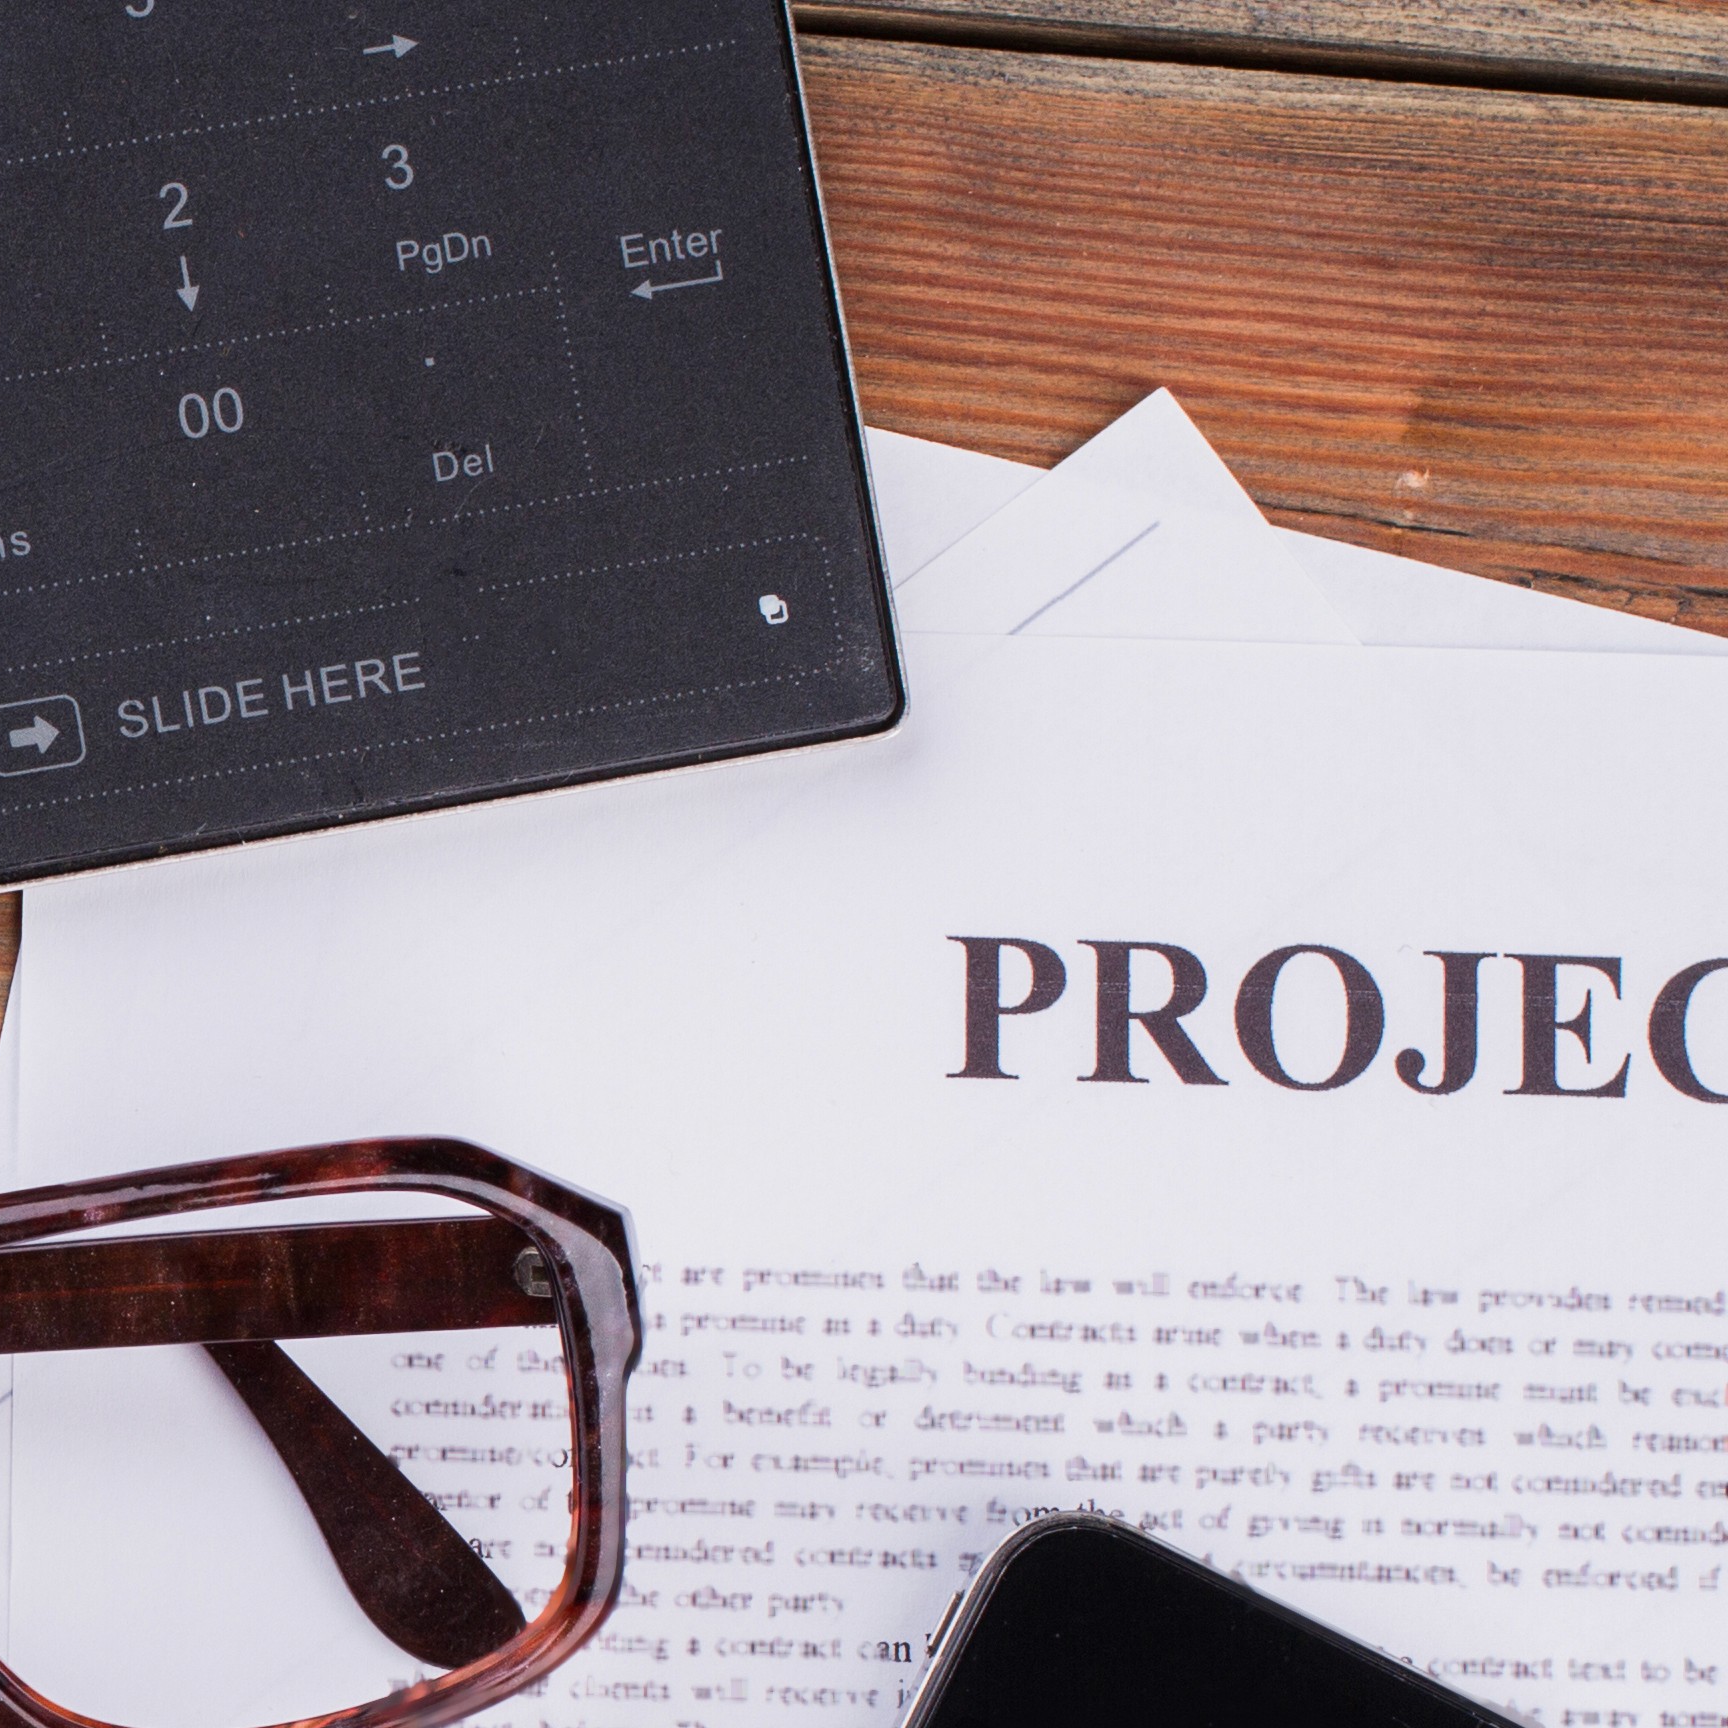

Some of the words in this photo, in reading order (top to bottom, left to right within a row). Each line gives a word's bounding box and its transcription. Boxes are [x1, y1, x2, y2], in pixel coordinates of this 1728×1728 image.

[381, 144, 415, 190] 3
[159, 181, 193, 230] 2
[396, 231, 492, 274] PgDn
[619, 228, 723, 269] Enter
[178, 386, 244, 439] 00
[432, 443, 494, 482] Del
[117, 677, 269, 738] SLIDE
[281, 651, 426, 711] HERE
